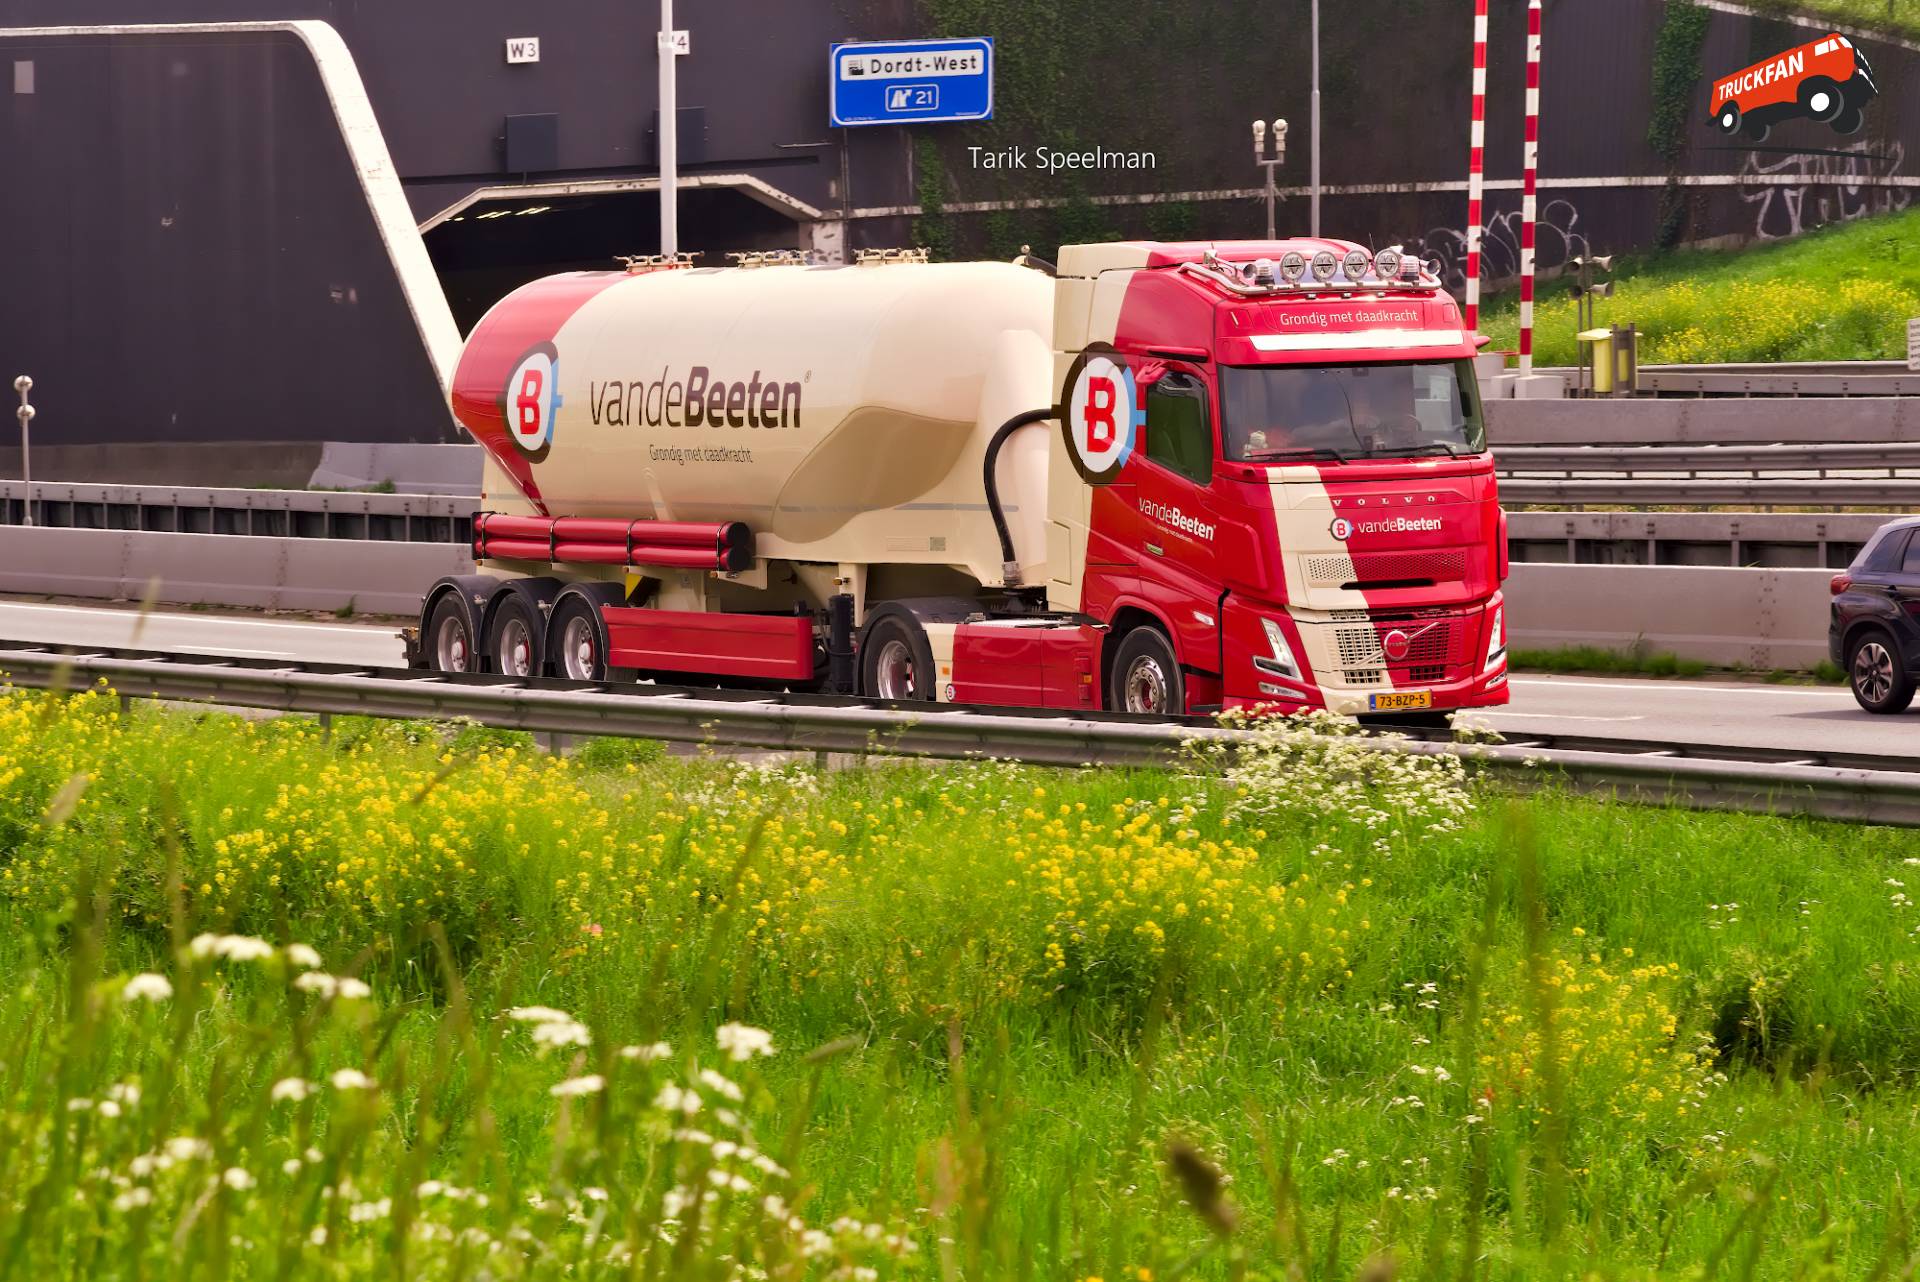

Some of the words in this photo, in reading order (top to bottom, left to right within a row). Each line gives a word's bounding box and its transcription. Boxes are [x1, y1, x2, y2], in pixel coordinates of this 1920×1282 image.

[510, 43, 537, 58] W3
[870, 55, 977, 74] Dordt-West
[915, 91, 933, 105] 21
[1280, 311, 1328, 327] Grondig
[1329, 311, 1353, 323] met
[1355, 309, 1419, 322] daadkracht
[517, 369, 543, 435] B
[1084, 376, 1116, 453] B
[649, 444, 685, 466] Grondig
[684, 448, 704, 462] met
[1333, 495, 1436, 507] VOLVO
[1380, 694, 1426, 707] 73-BZP-5
